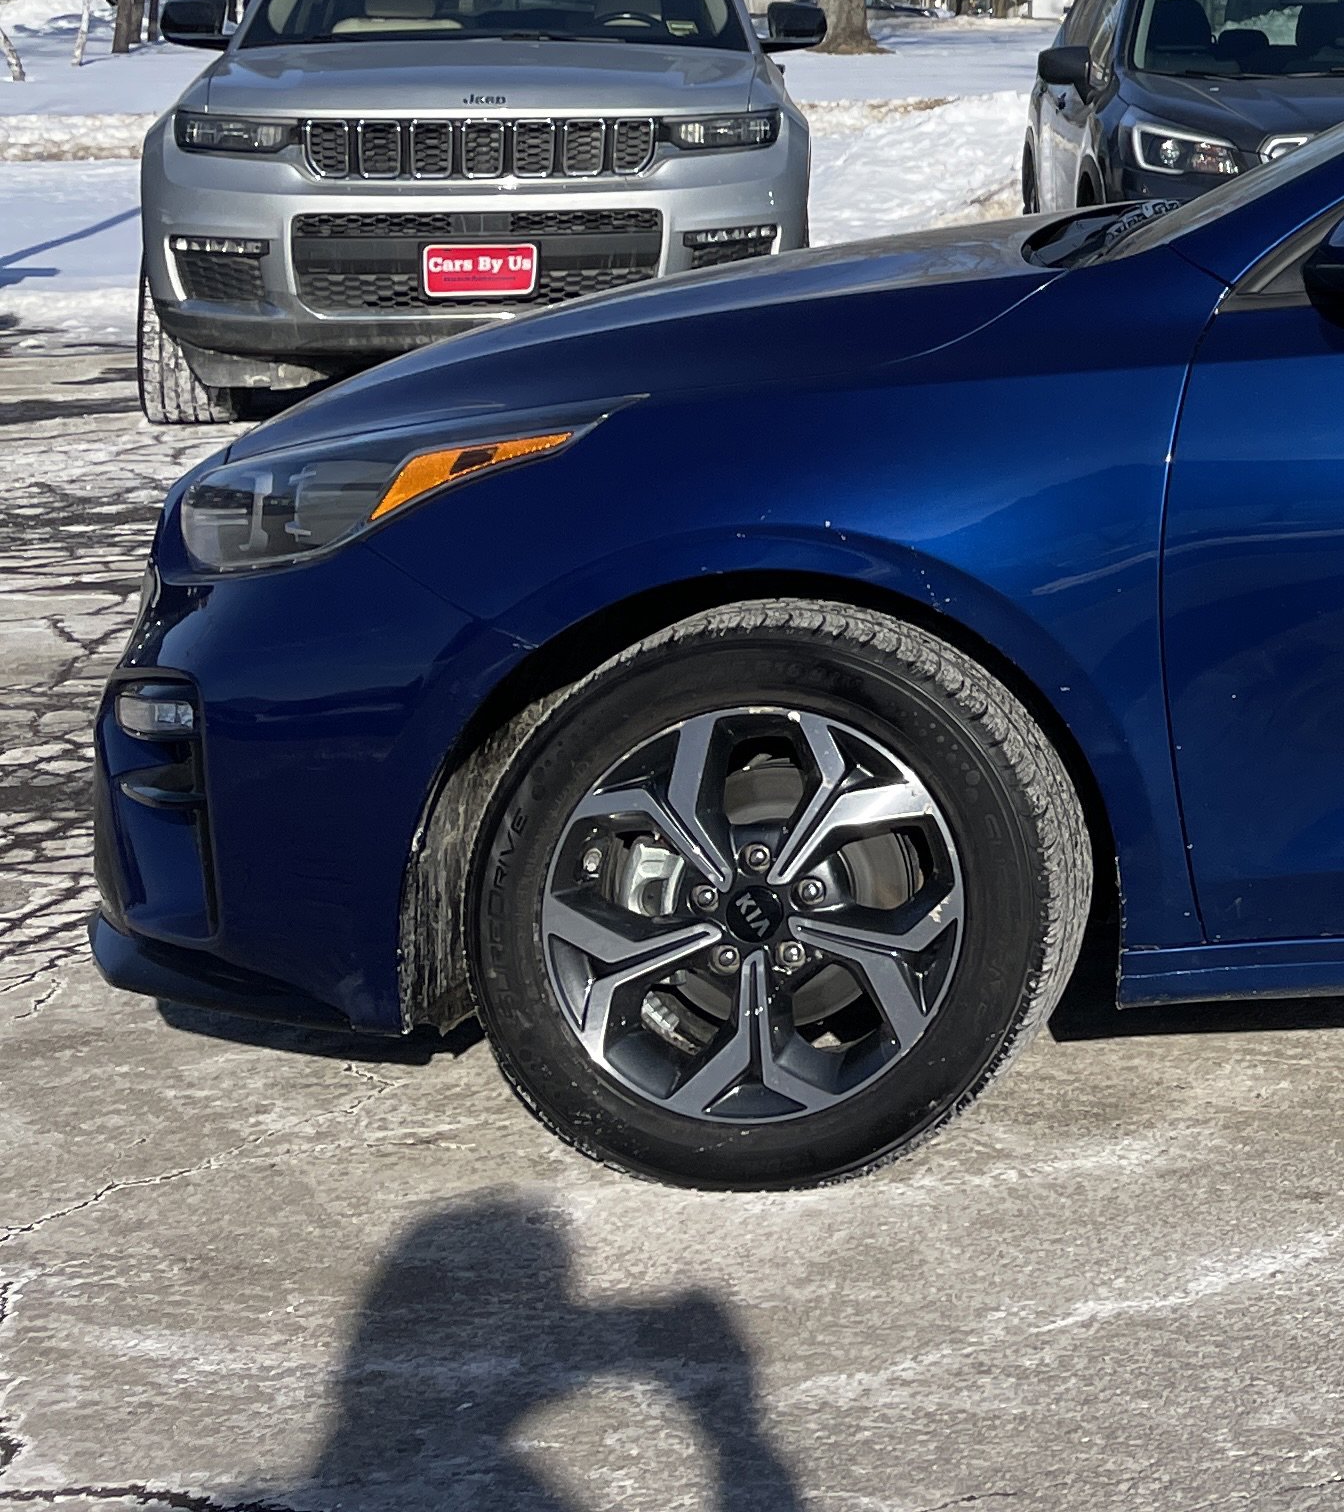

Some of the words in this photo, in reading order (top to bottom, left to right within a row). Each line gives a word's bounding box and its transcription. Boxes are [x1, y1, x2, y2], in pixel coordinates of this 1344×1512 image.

[428, 256, 473, 273] Cars
[477, 255, 503, 274] By
[507, 255, 532, 271] Us
[735, 891, 770, 938] KIA
